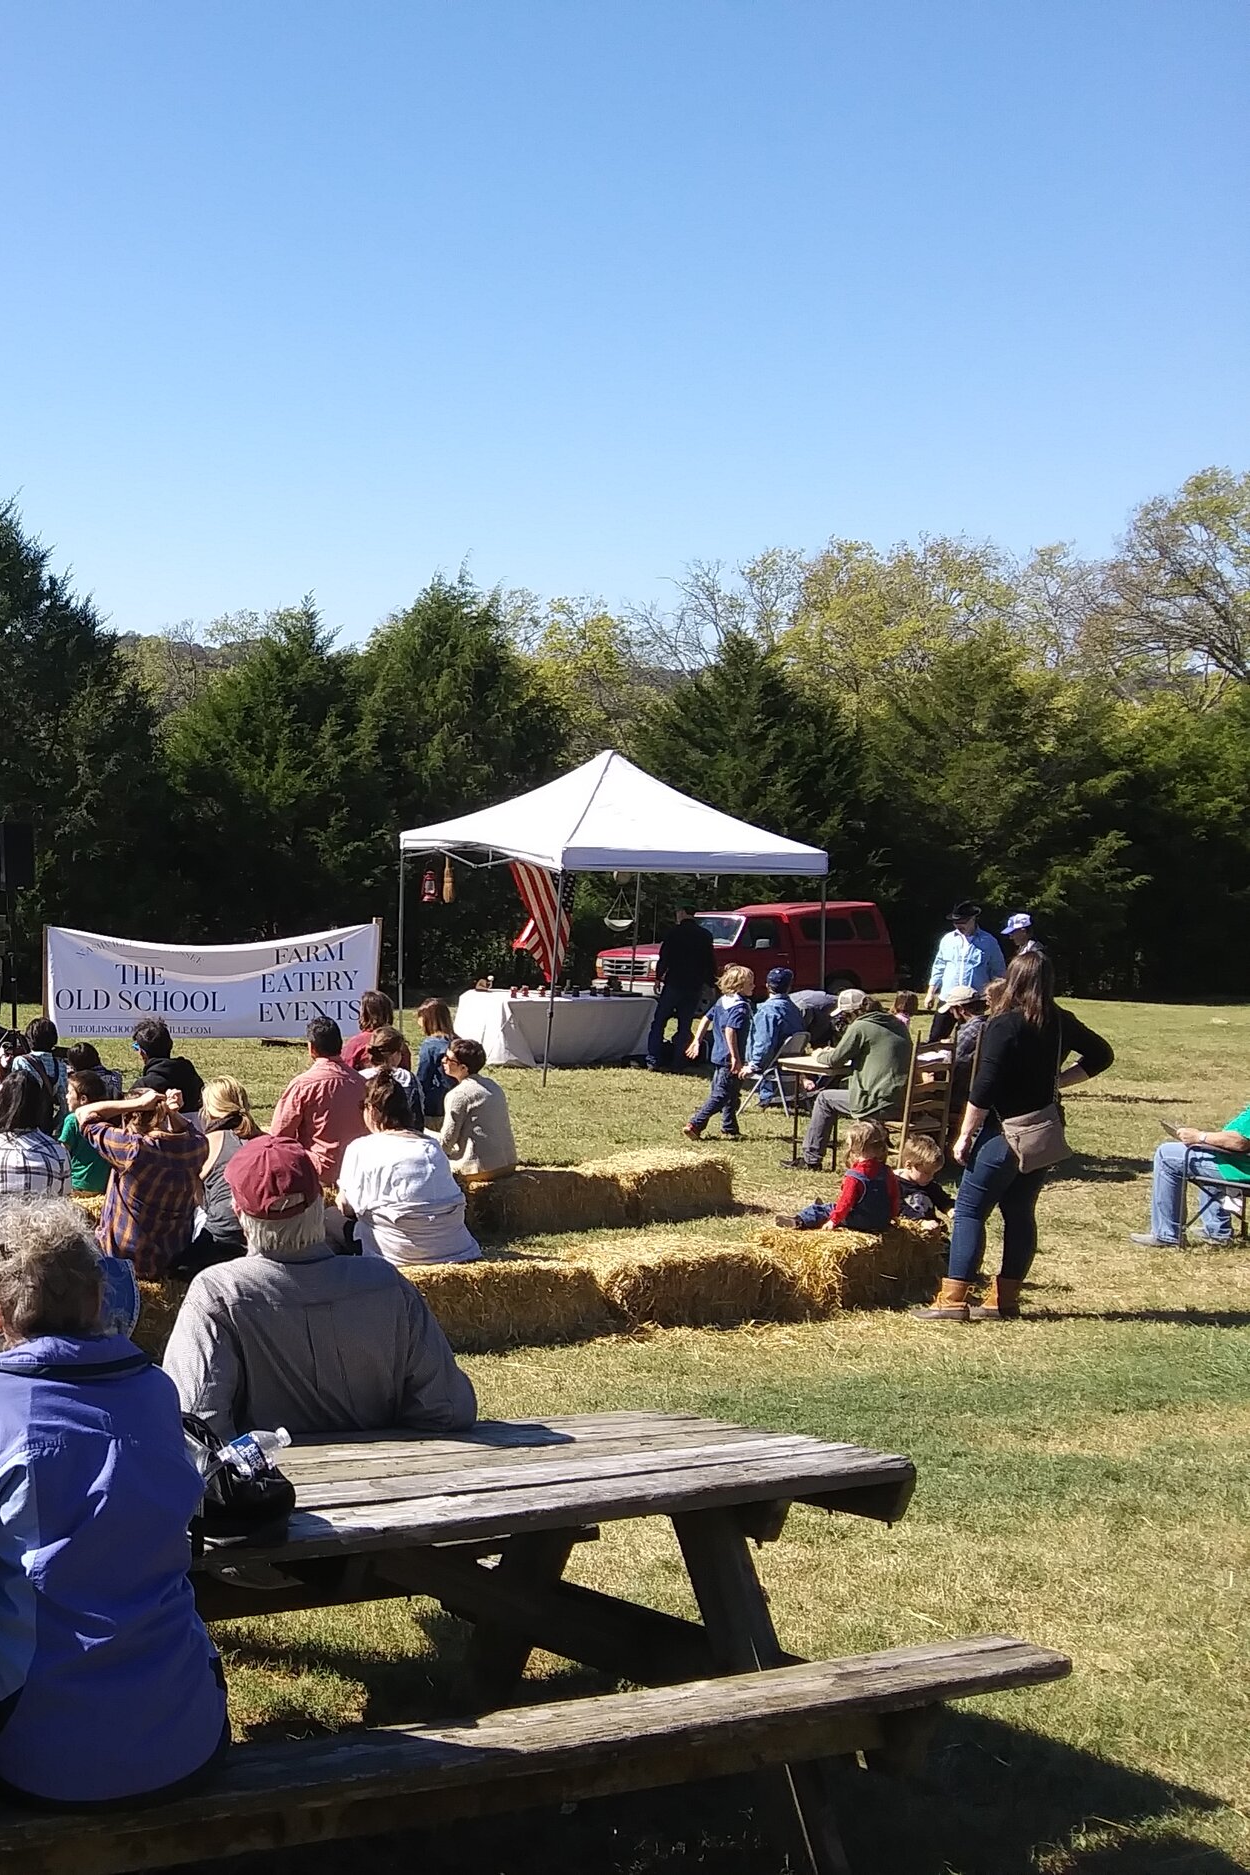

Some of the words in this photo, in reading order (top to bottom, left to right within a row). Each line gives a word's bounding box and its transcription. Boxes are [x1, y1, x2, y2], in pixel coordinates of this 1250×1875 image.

[275, 942, 344, 965] FARM
[115, 964, 166, 985] THE
[261, 970, 358, 993] EATERY
[55, 988, 110, 1010] OLD
[118, 989, 226, 1012] SCHOOL
[259, 1000, 361, 1022] EVENTS
